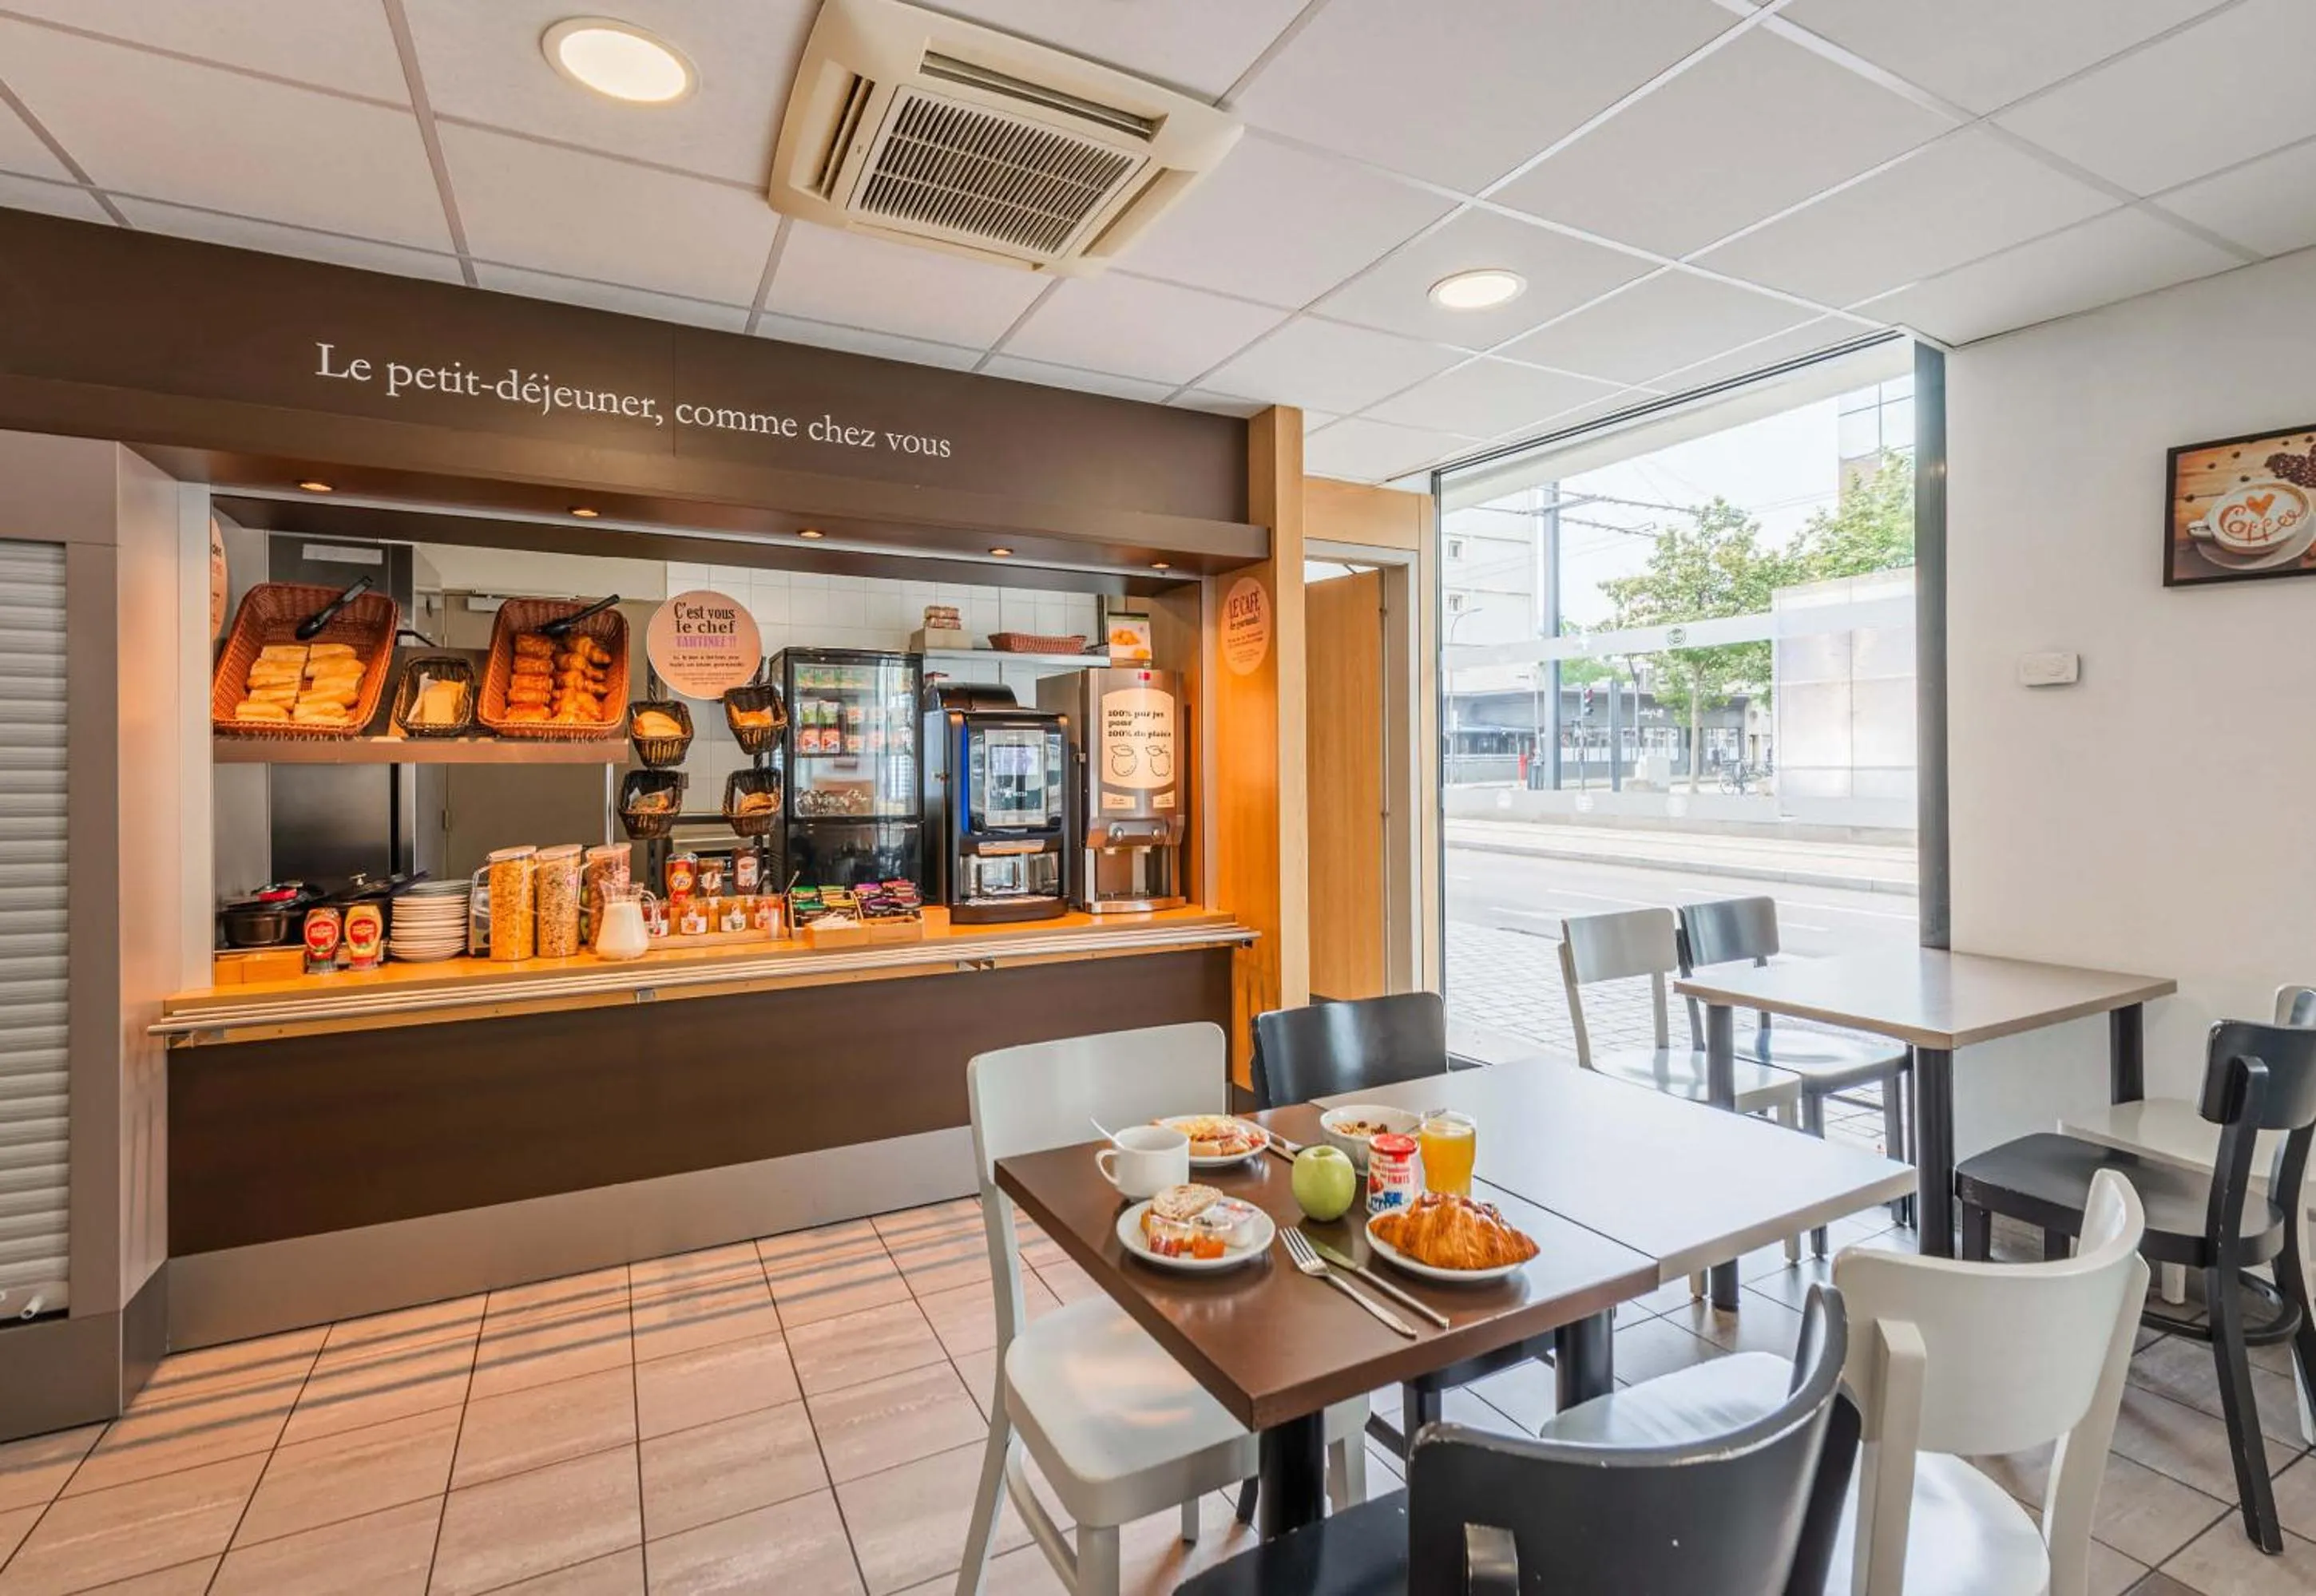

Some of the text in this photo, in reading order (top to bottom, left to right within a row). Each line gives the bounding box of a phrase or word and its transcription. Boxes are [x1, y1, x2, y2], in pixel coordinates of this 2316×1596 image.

[315, 342, 951, 457] Le petit-déjeuner, comme chez vous
[674, 602, 736, 620] C'est vous
[676, 620, 736, 634] le chef
